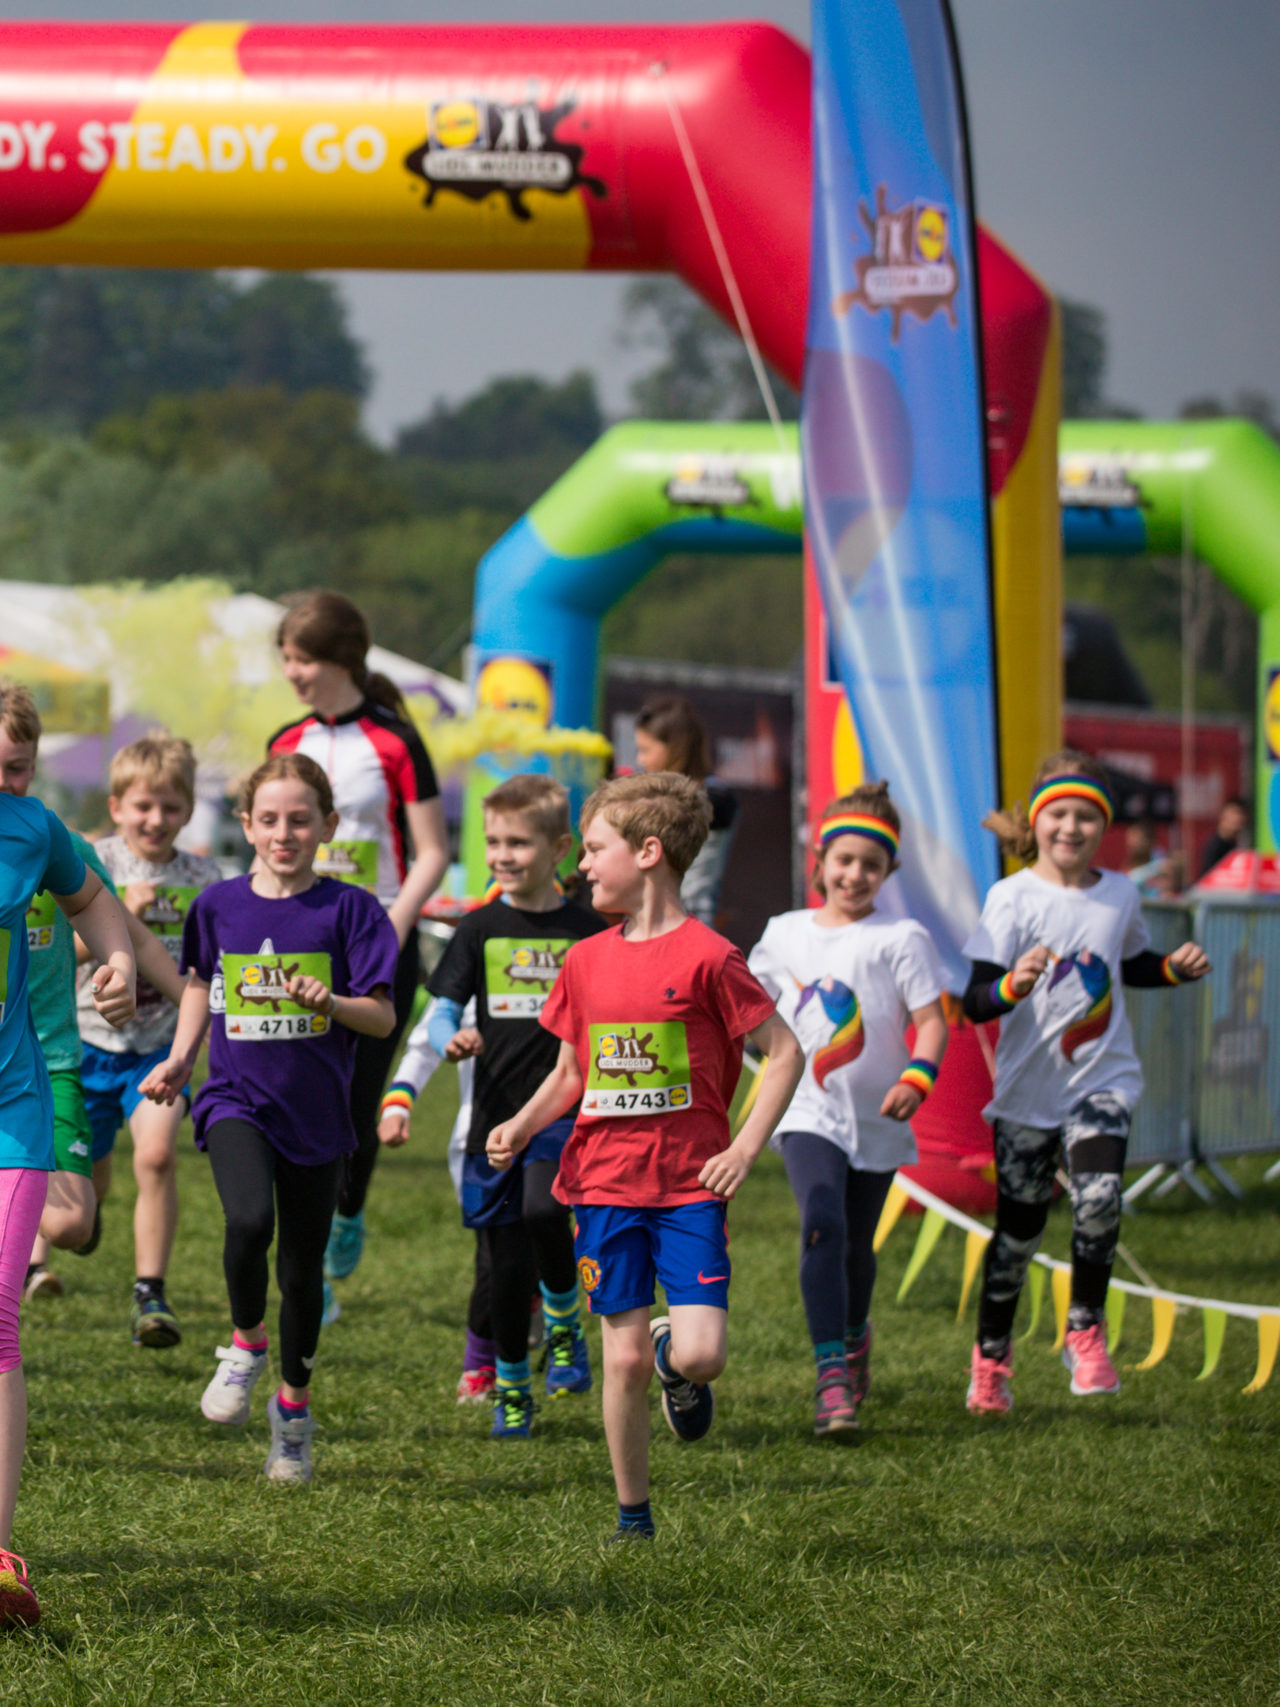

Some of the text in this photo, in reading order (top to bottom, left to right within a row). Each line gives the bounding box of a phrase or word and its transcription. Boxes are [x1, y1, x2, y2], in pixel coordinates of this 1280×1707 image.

[78, 120, 288, 173] STEADY.
[300, 121, 388, 173] GO
[261, 987, 286, 995] MUDD
[259, 1018, 308, 1034] 4718
[614, 1091, 666, 1110] 4743
